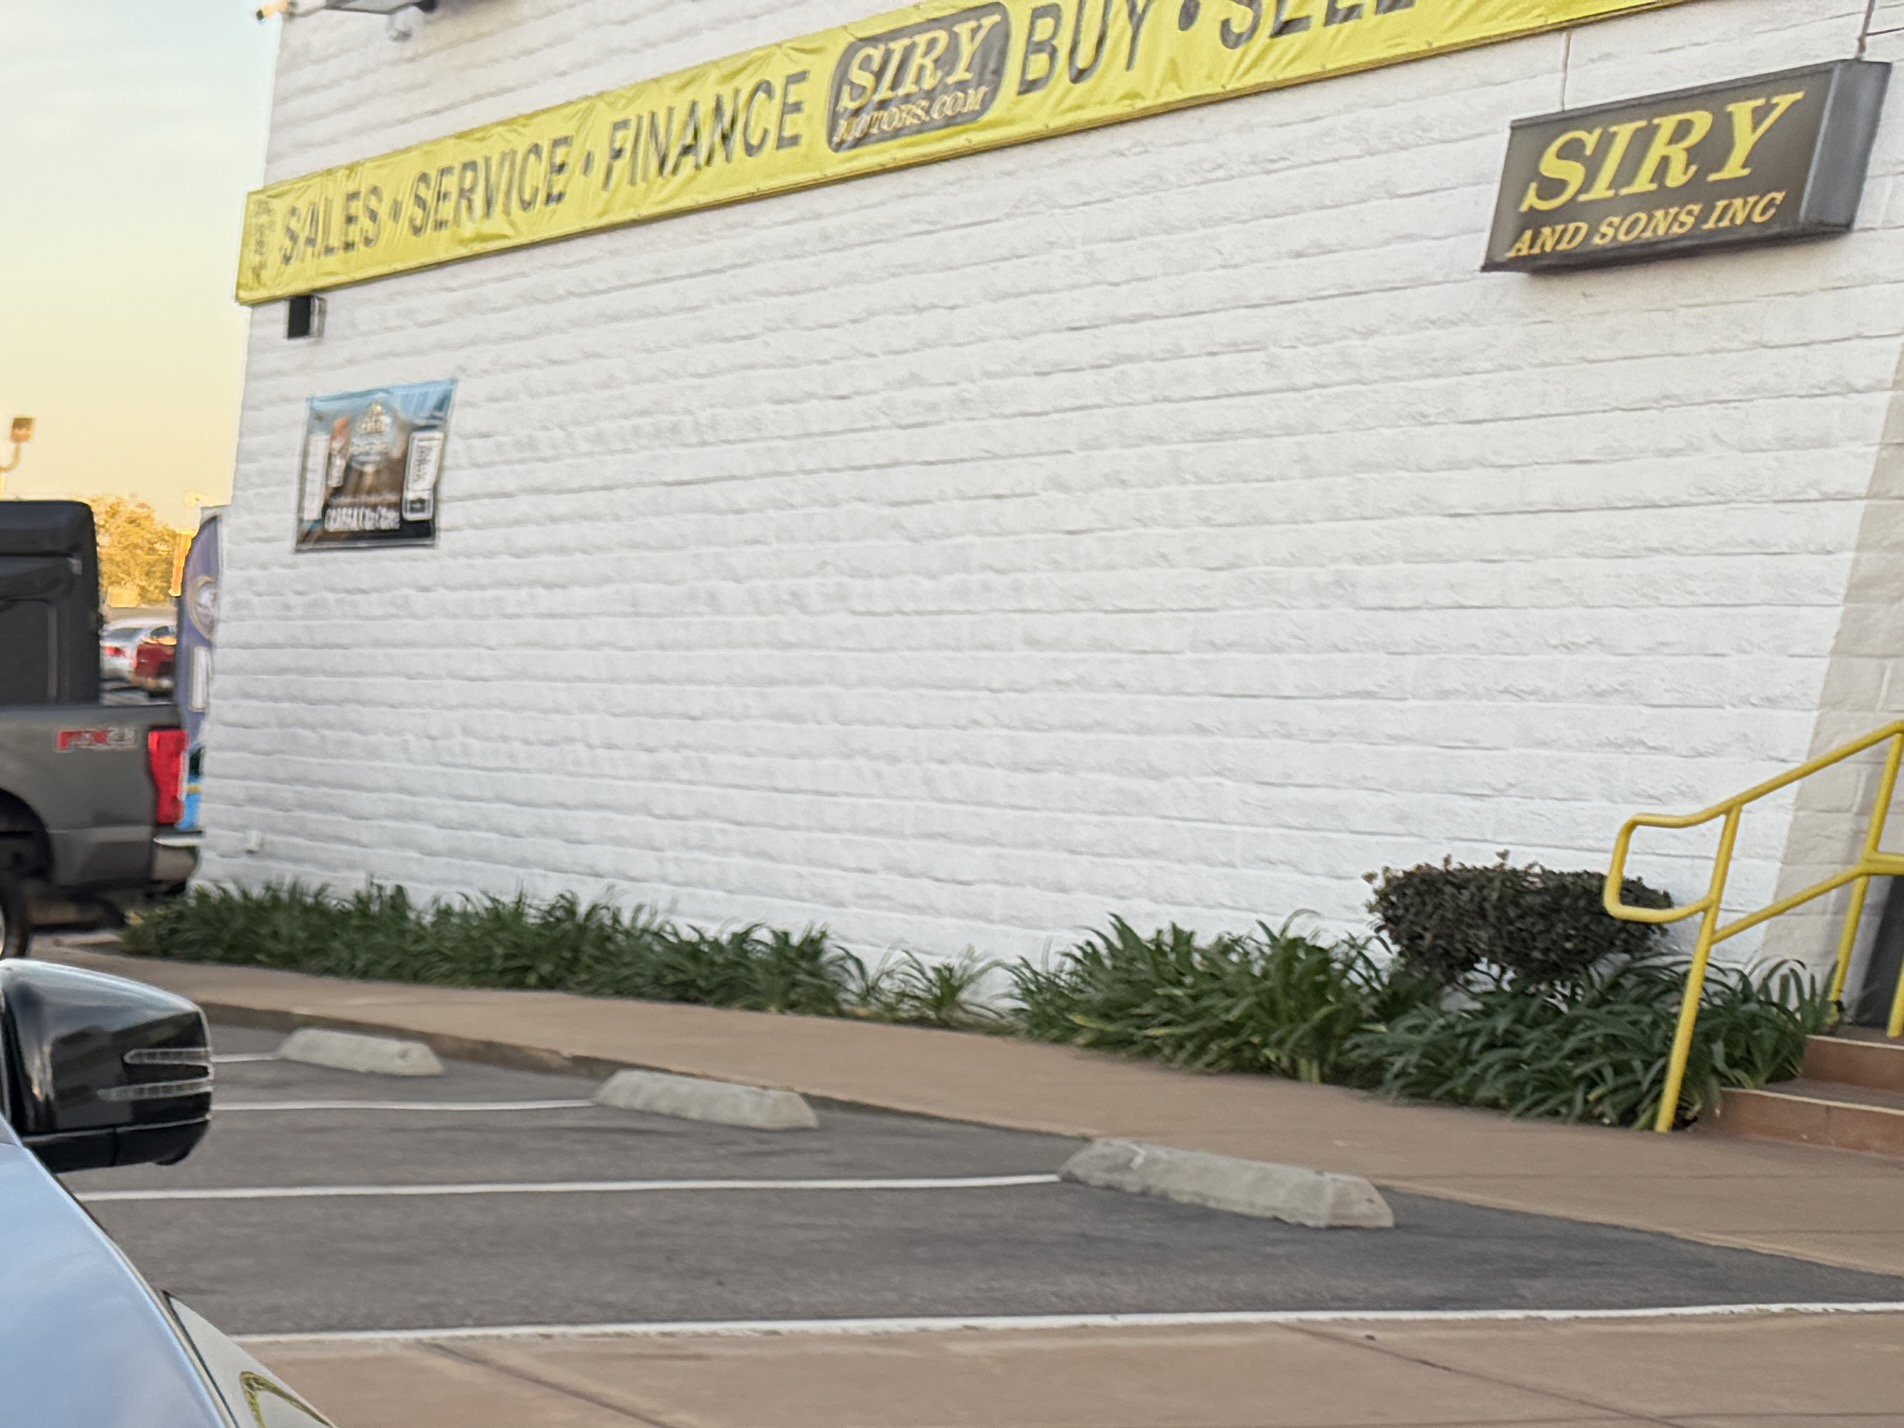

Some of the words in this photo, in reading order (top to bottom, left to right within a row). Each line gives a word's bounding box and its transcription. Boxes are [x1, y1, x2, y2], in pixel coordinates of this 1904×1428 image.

[835, 13, 1001, 111] SIRY
[1017, 0, 1156, 96] BUY
[833, 86, 990, 145] MOTORS.COM
[1519, 91, 1804, 213] SIRY
[279, 185, 383, 266] SALES
[408, 136, 573, 238] SERVICE
[601, 69, 809, 192] FINANCE
[1505, 221, 1589, 258] AND
[1592, 203, 1702, 245] SONS
[1701, 190, 1786, 230] INC
